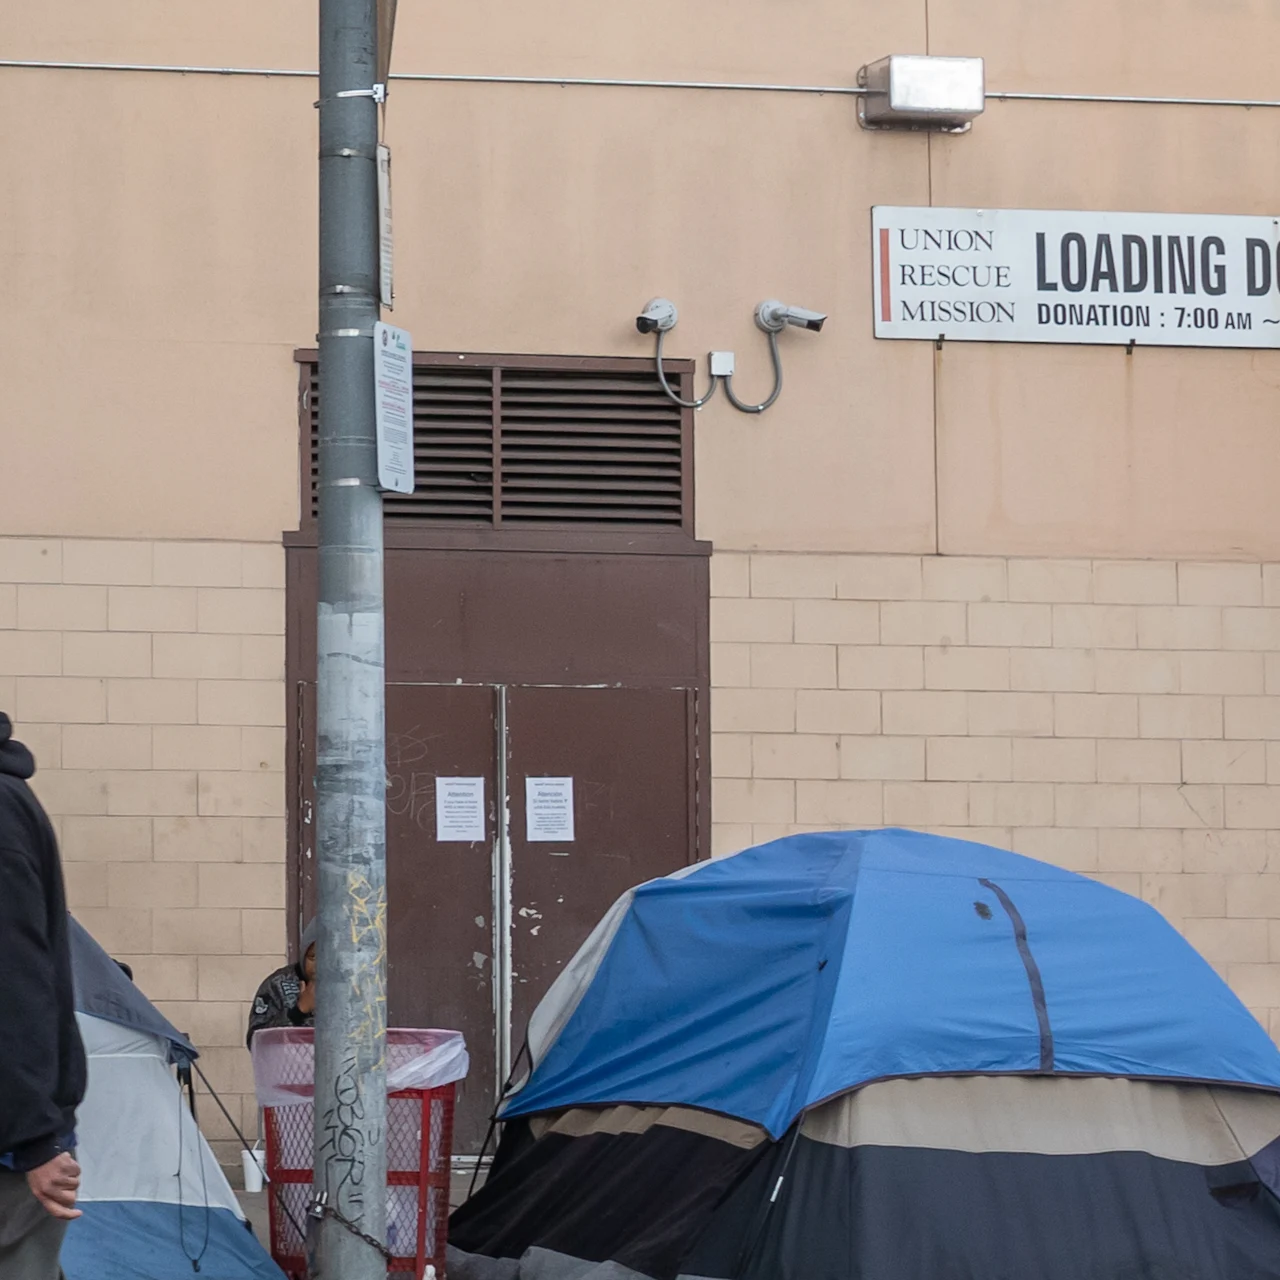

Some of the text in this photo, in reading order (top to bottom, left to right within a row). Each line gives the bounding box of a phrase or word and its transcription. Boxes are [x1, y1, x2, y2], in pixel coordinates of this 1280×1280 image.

[899, 228, 994, 251] UNION
[899, 264, 1011, 288] RESCUE
[1035, 231, 1280, 297] LOADING D
[900, 300, 1016, 323] MISSION
[1037, 302, 1151, 328] DONATION
[1174, 306, 1219, 330] 7:00
[1224, 311, 1252, 330] AM
